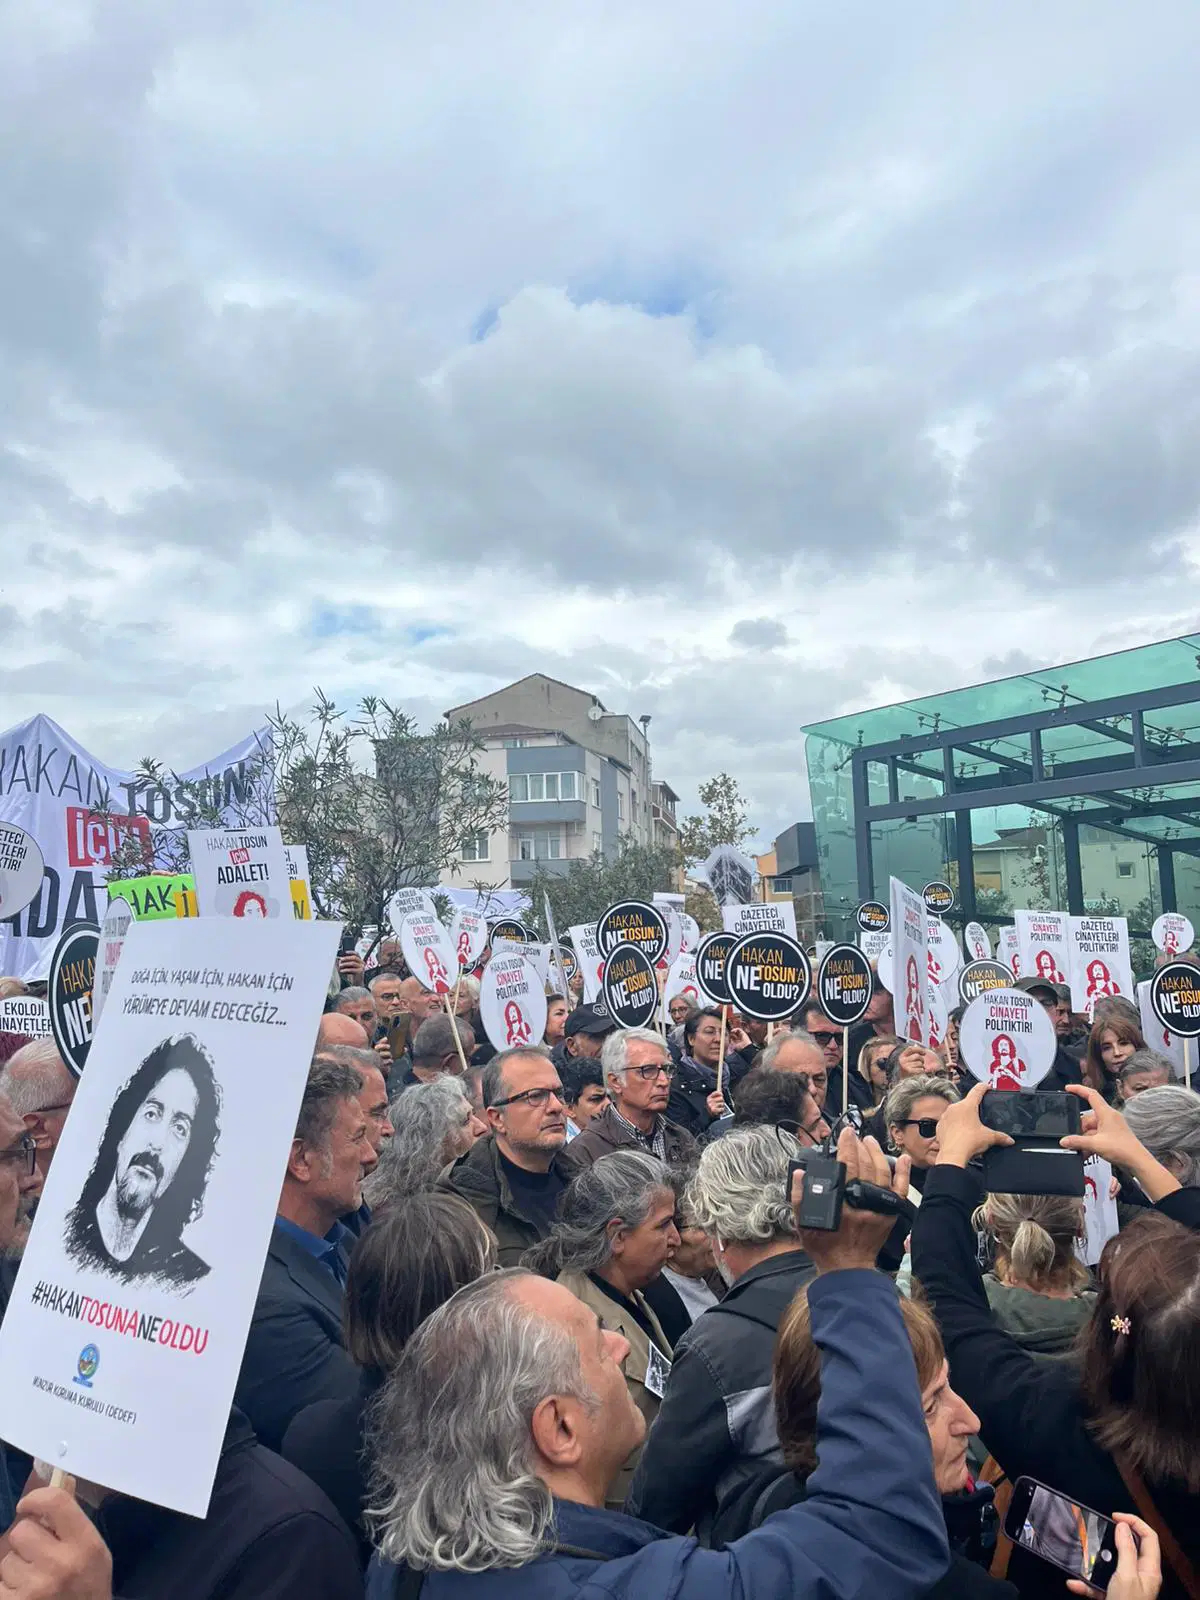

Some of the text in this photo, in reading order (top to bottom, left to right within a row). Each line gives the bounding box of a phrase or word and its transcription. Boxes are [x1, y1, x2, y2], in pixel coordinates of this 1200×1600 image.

[207, 836, 268, 851] HAKAN TOSUN
[218, 863, 269, 884] ADALET!
[608, 913, 643, 928] HAKAN
[740, 906, 779, 920] GAZETECİ
[734, 917, 786, 933] CİNAYETLERİ
[1081, 920, 1114, 931] GAZETECİ
[624, 926, 663, 941] TOSUN'A
[1075, 931, 1120, 942] CİNAYETLERİ
[1080, 942, 1119, 953] POLİTİKTİR!
[508, 957, 525, 970] TOSUN
[741, 947, 783, 965] HAKAN
[610, 958, 637, 981] HAKAN
[705, 959, 722, 980] NE
[758, 965, 806, 984] TOSUN'A
[827, 960, 854, 974] HAKAN
[967, 969, 996, 980] HAKAN
[171, 969, 200, 988] YAŞAM
[227, 972, 265, 989] HAKAN
[267, 972, 294, 993] İÇİN
[736, 965, 760, 991] NE
[1161, 976, 1193, 990] HAKAN
[611, 981, 631, 1010] NE
[763, 983, 799, 1000] OLDU?
[825, 977, 842, 1001] NE
[843, 989, 866, 1005] OLDU?
[631, 987, 653, 1009] OLDU?
[984, 994, 1033, 1008] HAKAN TOSUN
[1160, 992, 1181, 1014] NE
[4, 1001, 44, 1016] EKOLOJİ
[122, 994, 287, 1026] YÜRÜMEYE DEVAM EDECEĞİZ...
[990, 1006, 1028, 1020] CİNAYETİ
[1182, 1004, 1200, 1018] OLD
[985, 1018, 1033, 1034] POLİTİKTİR!
[31, 1280, 209, 1354] #HAKANTOSUNANEOLDU
